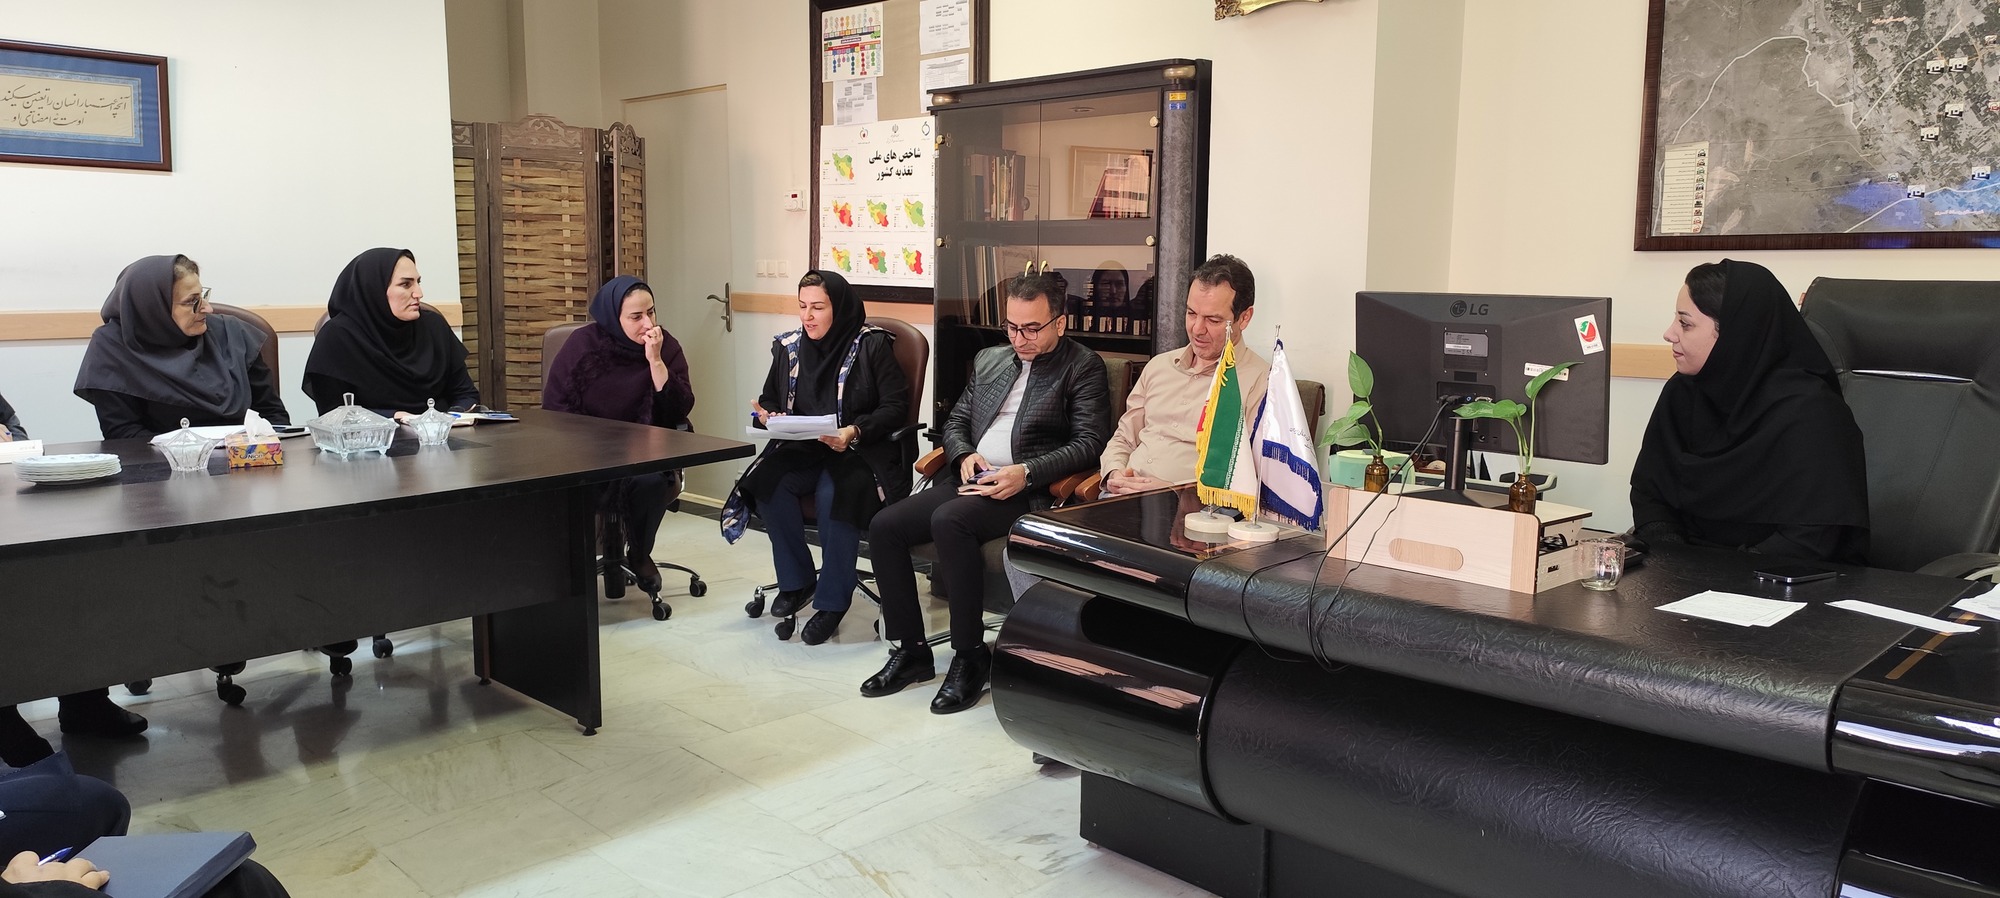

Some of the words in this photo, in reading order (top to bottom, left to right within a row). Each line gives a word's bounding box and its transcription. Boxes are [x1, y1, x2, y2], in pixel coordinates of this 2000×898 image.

[52, 93, 80, 111] انسان
[868, 150, 882, 164] ملی
[883, 149, 897, 163] های
[898, 147, 922, 163] شاخص
[876, 166, 894, 181] کشور
[895, 165, 914, 180] تغذیه
[1469, 303, 1489, 316] LG
